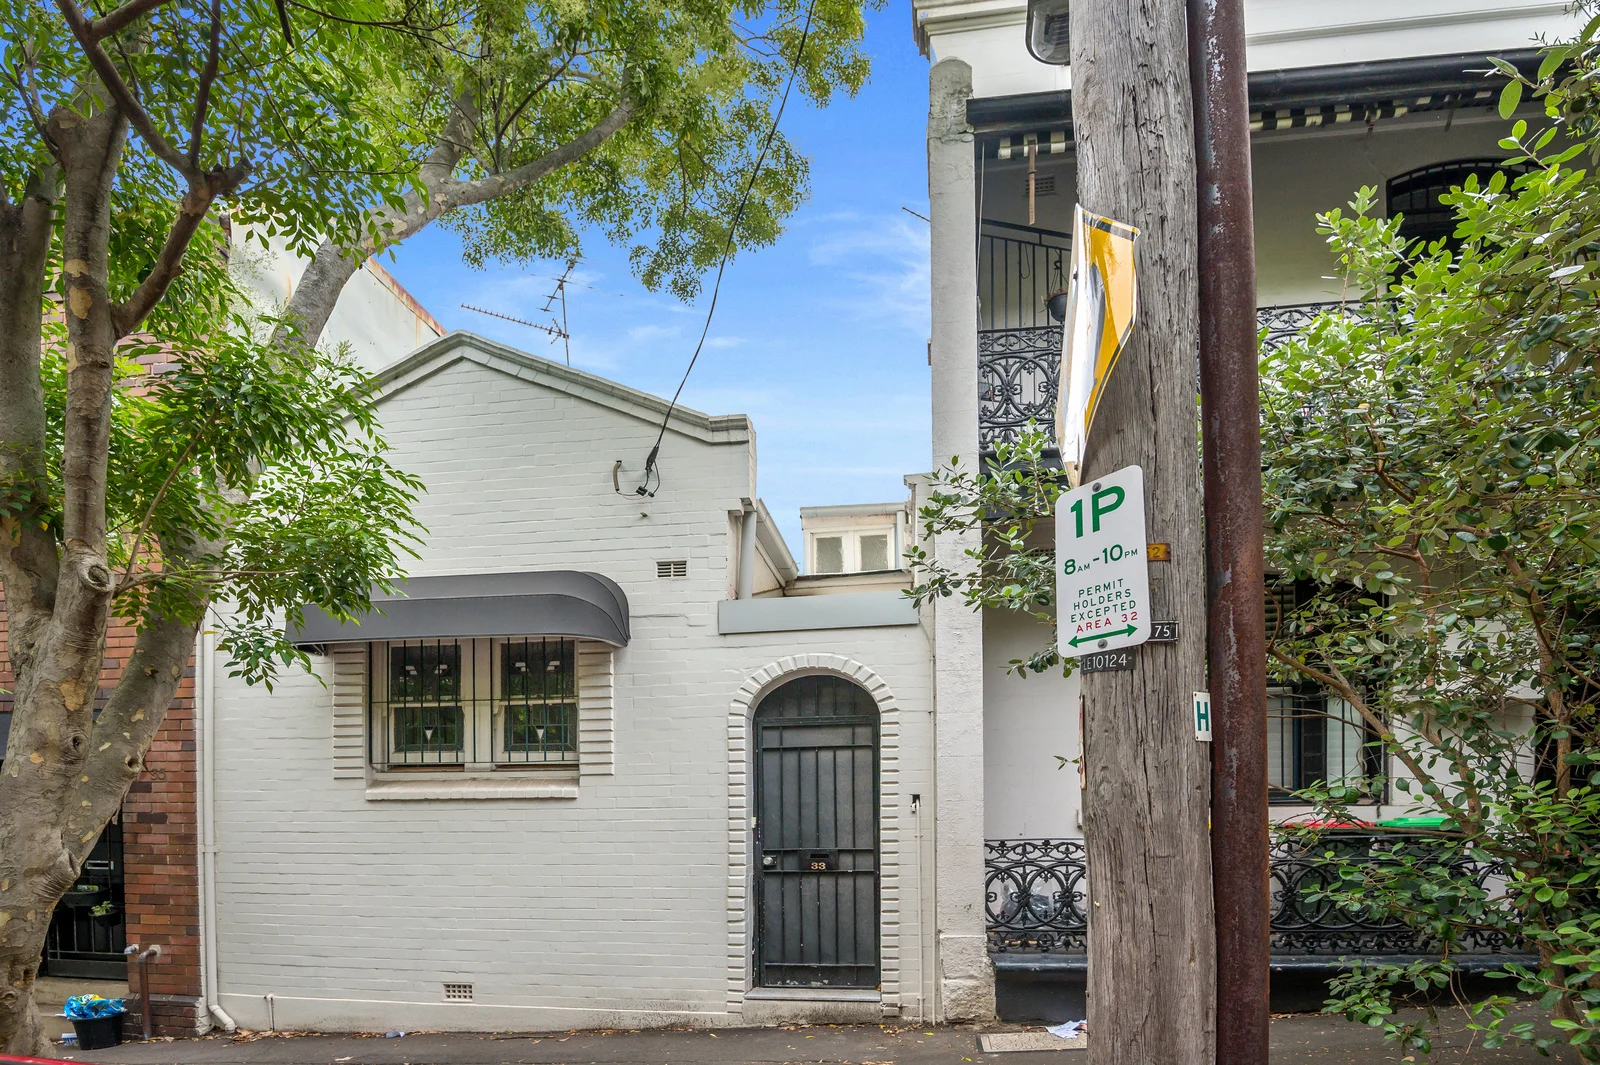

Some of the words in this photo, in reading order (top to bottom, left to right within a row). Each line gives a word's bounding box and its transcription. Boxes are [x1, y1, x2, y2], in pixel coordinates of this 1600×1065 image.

[1070, 485, 1125, 538] 1P
[1074, 588, 1131, 611] HOLDERS
[1079, 578, 1123, 598] PERMIT
[1070, 600, 1136, 623] EXCEPTED
[1076, 617, 1112, 633] AREA
[1121, 611, 1138, 623] 32
[1196, 701, 1210, 732] H
[811, 862, 826, 870] 33
